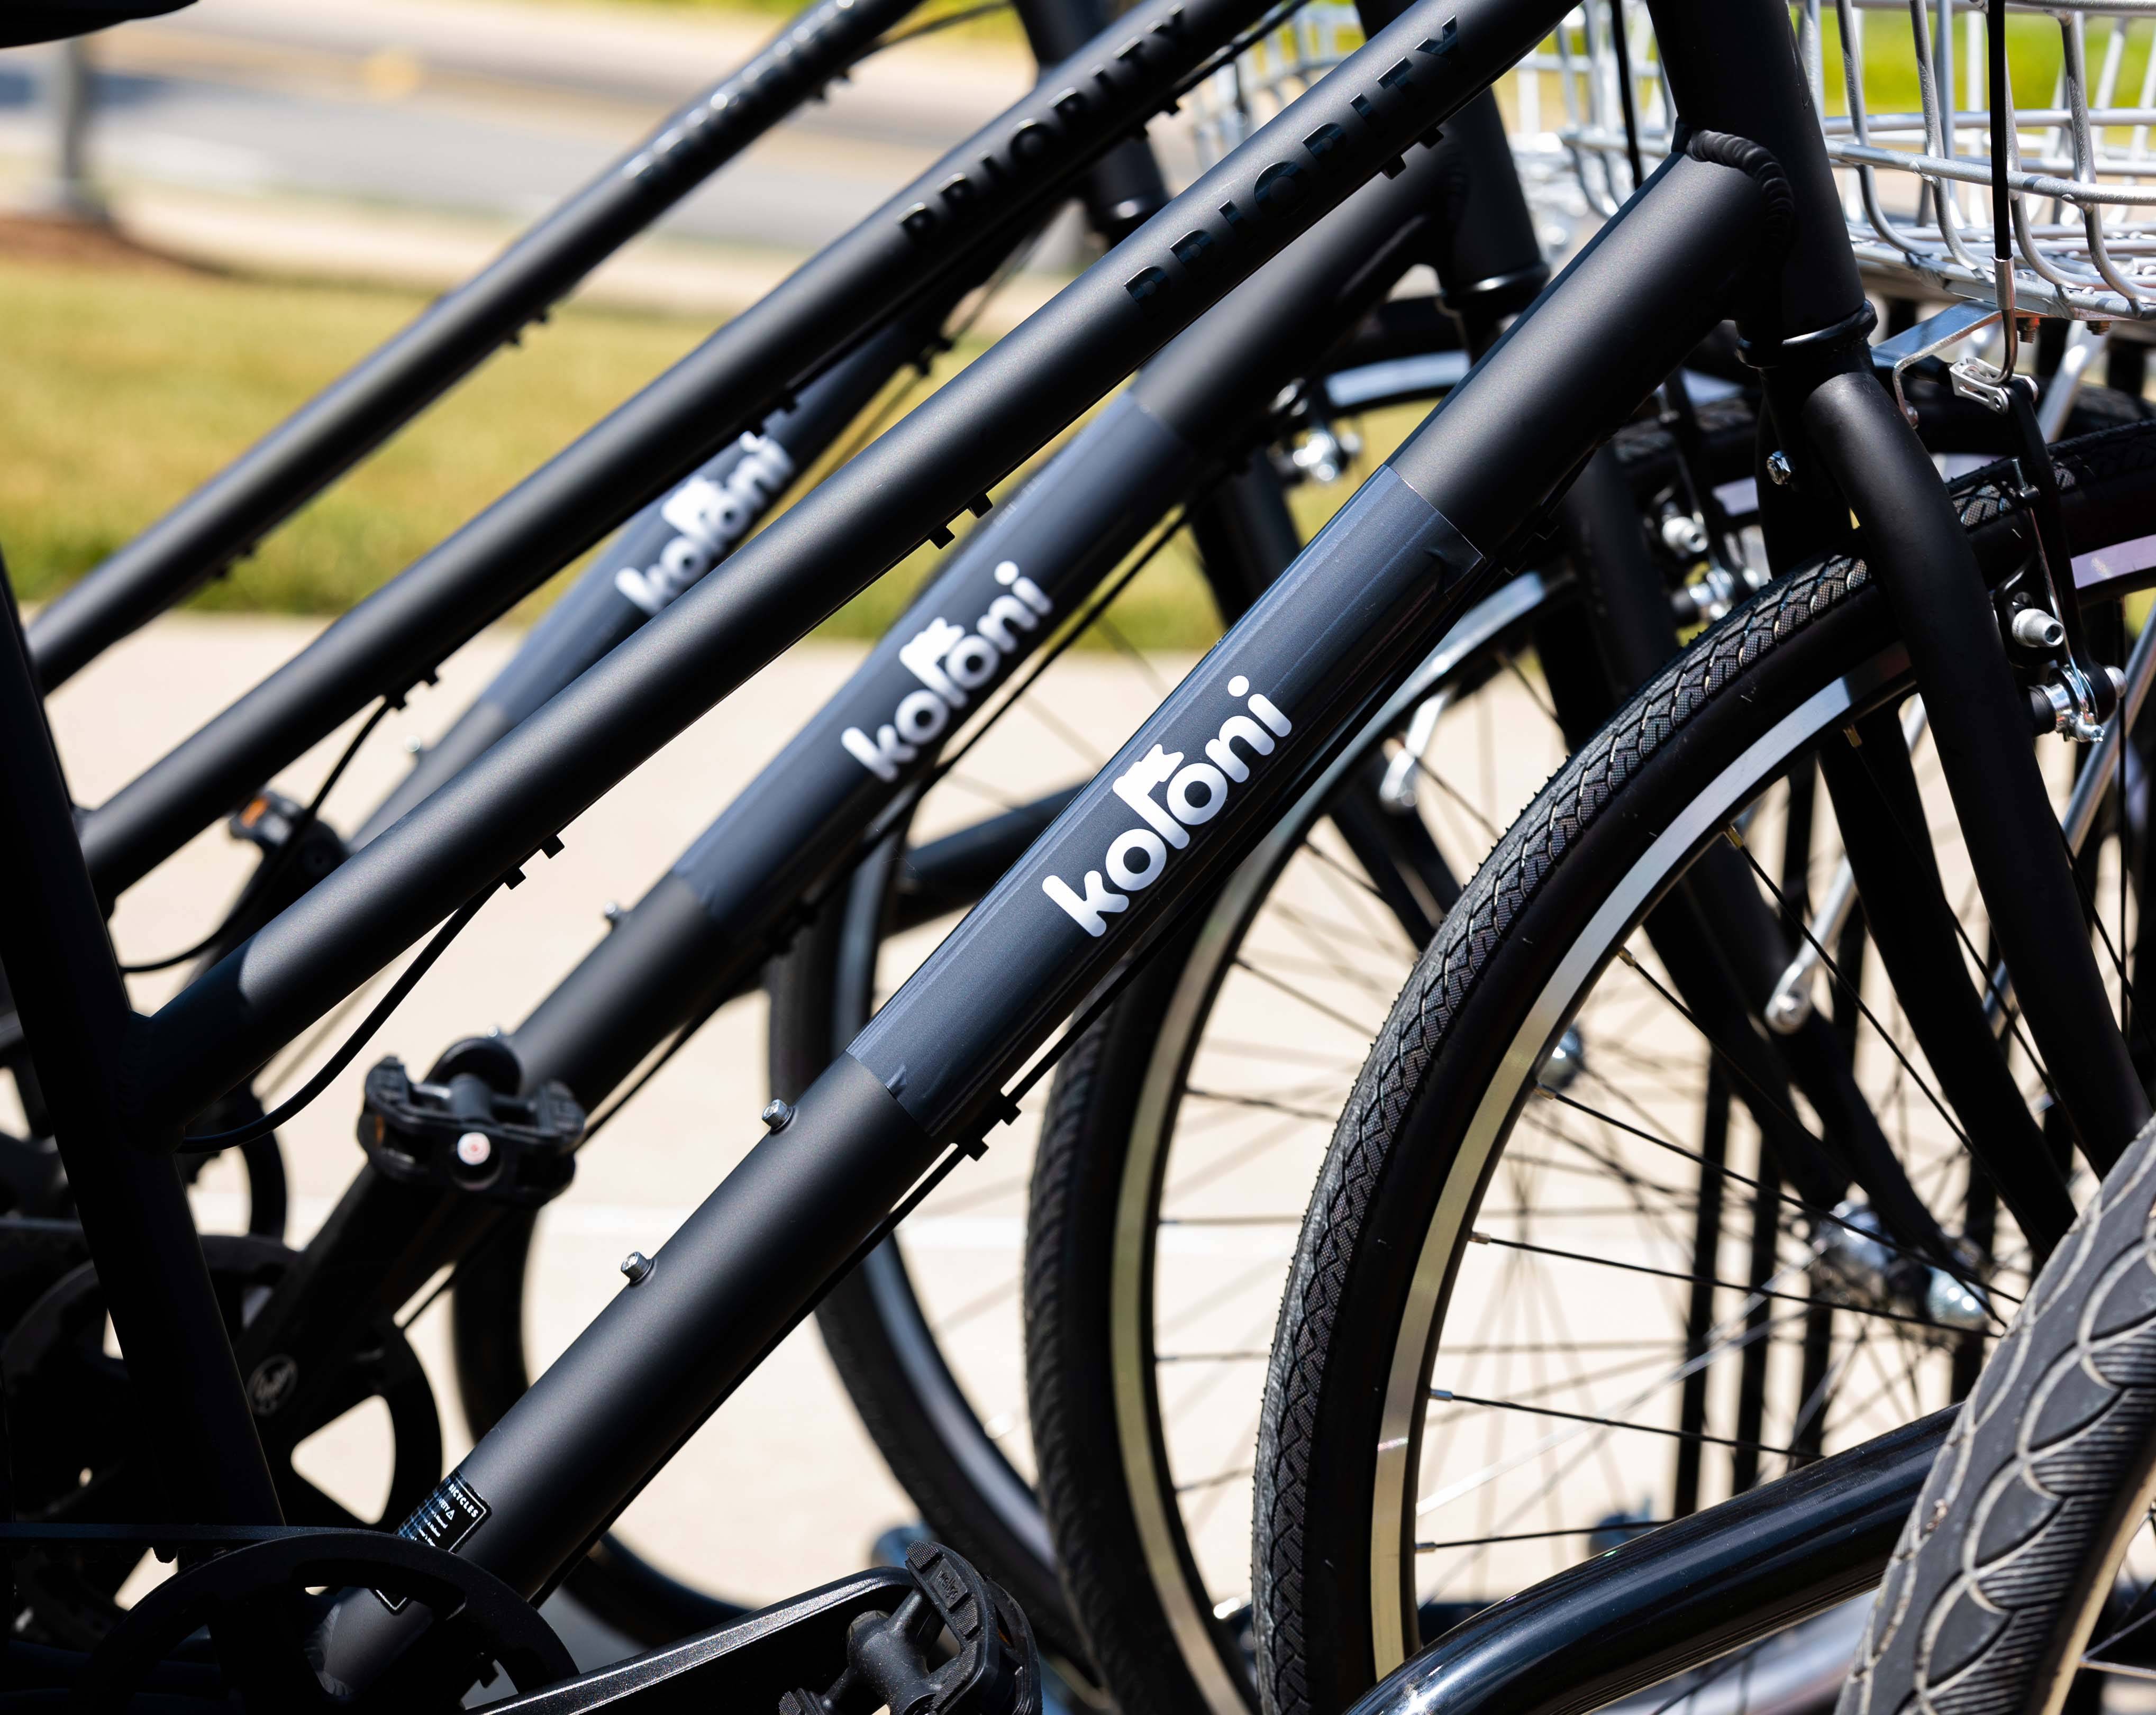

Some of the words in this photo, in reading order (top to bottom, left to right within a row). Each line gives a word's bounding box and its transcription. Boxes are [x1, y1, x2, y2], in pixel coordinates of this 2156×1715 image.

[841, 560, 1053, 781] koloni
[1042, 675, 1293, 937] koloni
[448, 1483, 479, 1518] BICYCLES
